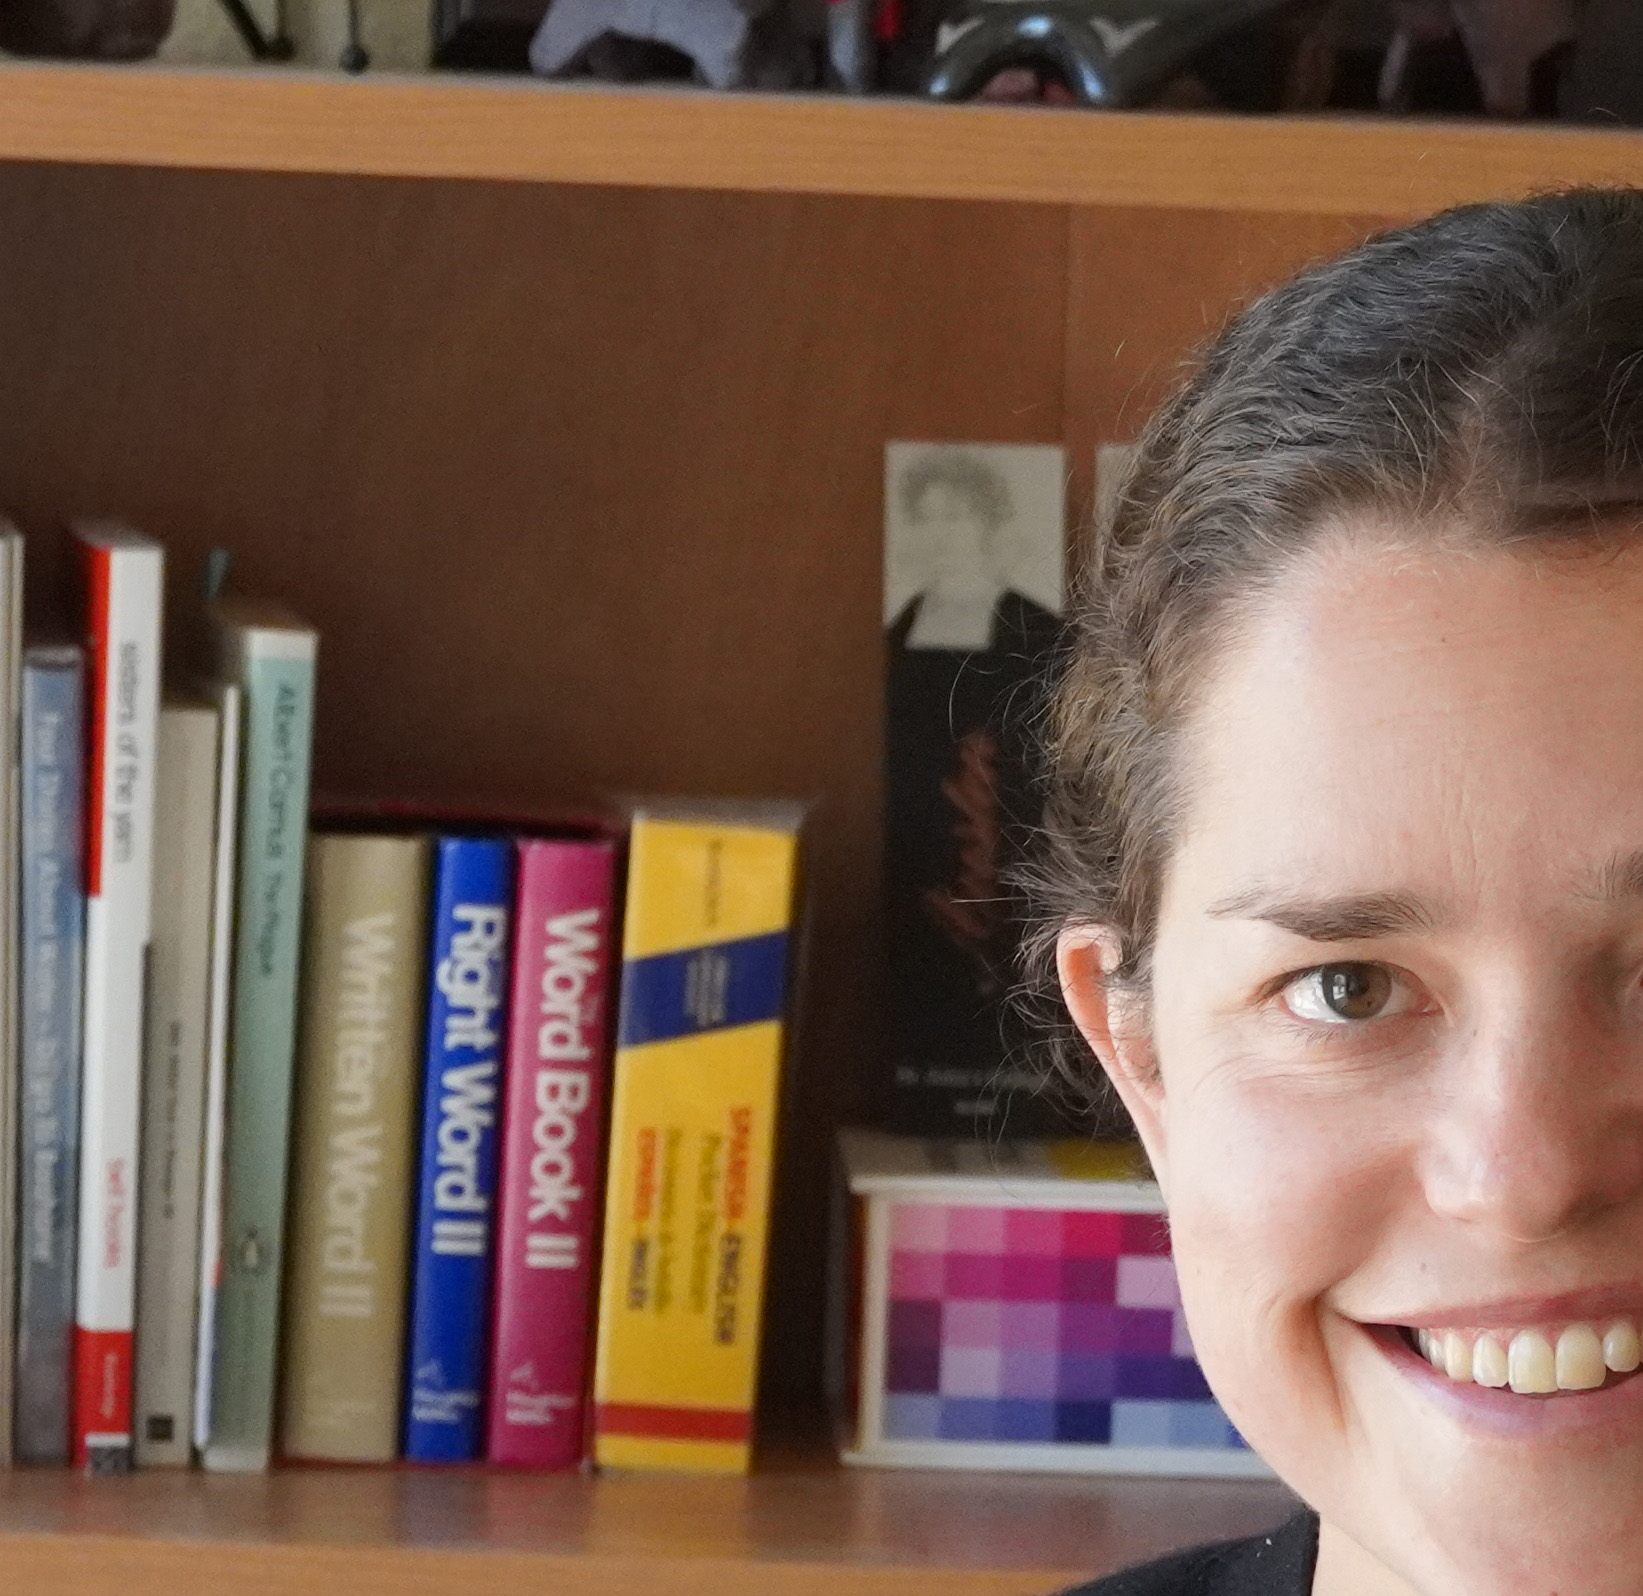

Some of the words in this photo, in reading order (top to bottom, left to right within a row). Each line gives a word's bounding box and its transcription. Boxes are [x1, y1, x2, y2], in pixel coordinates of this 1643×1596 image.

[114, 763, 138, 805] the
[272, 683, 298, 761] Albert
[335, 913, 396, 1115] Written
[437, 904, 507, 1053] Right
[539, 908, 602, 1061] Word
[326, 1121, 387, 1271] Word
[434, 1059, 499, 1213] Word
[529, 1070, 592, 1220] Book
